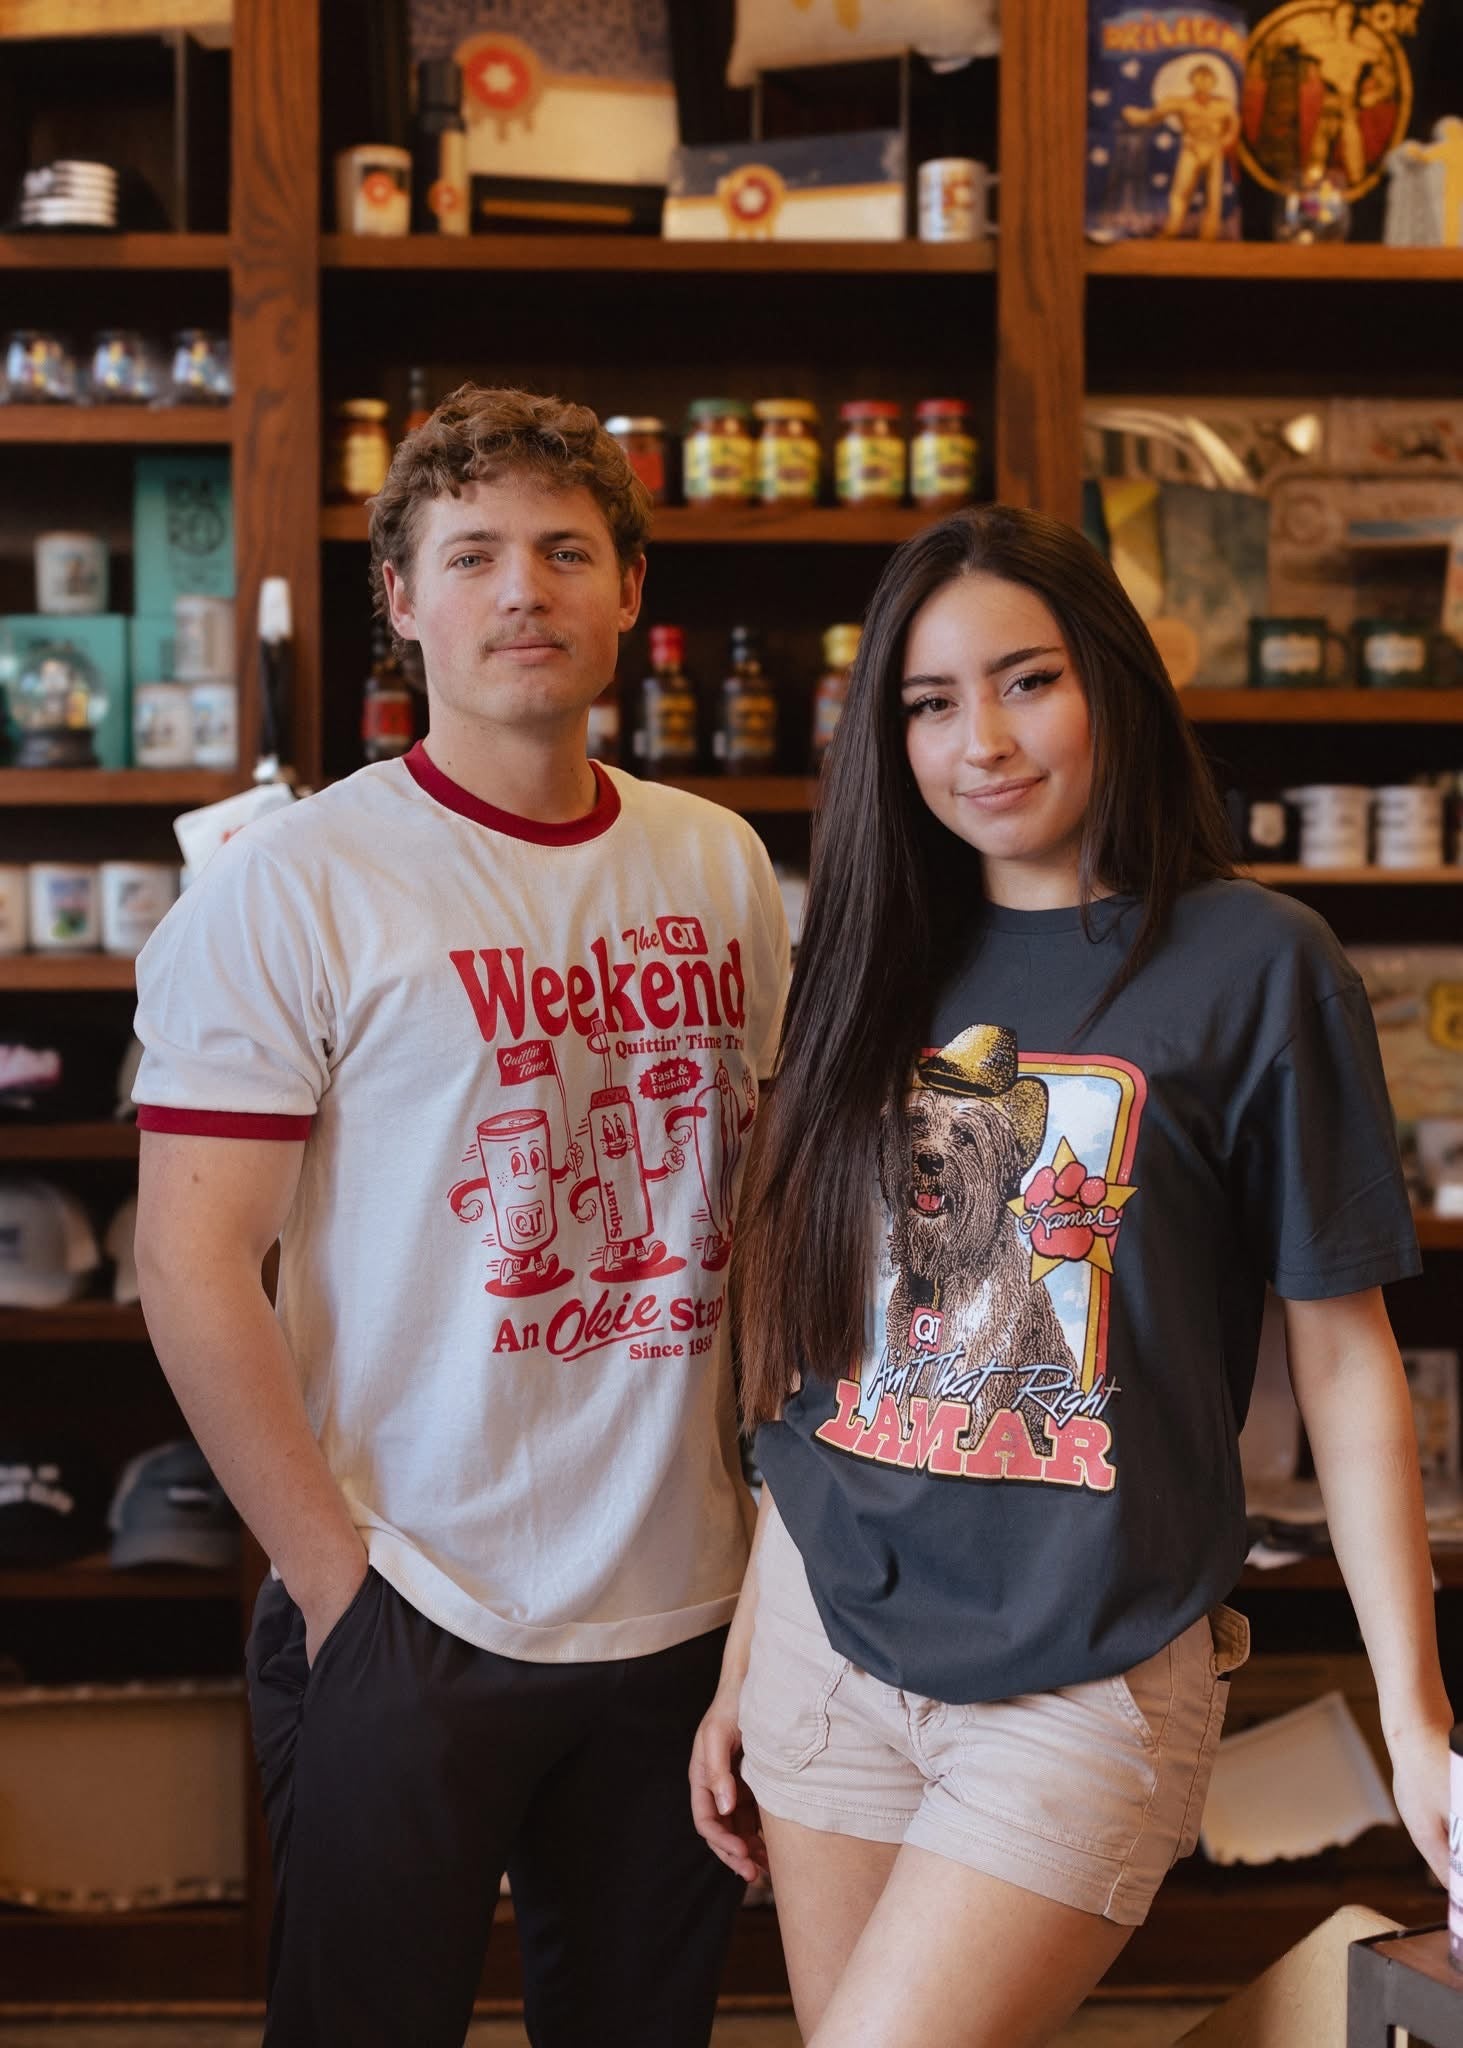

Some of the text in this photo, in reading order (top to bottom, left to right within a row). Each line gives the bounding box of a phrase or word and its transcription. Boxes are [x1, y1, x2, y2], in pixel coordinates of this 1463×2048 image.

[622, 921, 698, 955] The QT
[449, 936, 746, 1042] Weekend
[502, 1043, 543, 1067] Quittin'
[615, 1035, 682, 1059] Quittin'
[686, 1033, 722, 1050] Time
[519, 1058, 549, 1078] Time!
[650, 1063, 689, 1085] Fast &
[652, 1076, 691, 1095] Friendly
[511, 1206, 544, 1238] QT
[1020, 1200, 1121, 1239] Lamar
[492, 1318, 541, 1353] An
[546, 1289, 664, 1356] Okie
[914, 1313, 943, 1346] QT
[629, 1343, 684, 1361] Since
[867, 1343, 1122, 1429] Ain't That Right
[814, 1378, 1117, 1492] LAMAR
